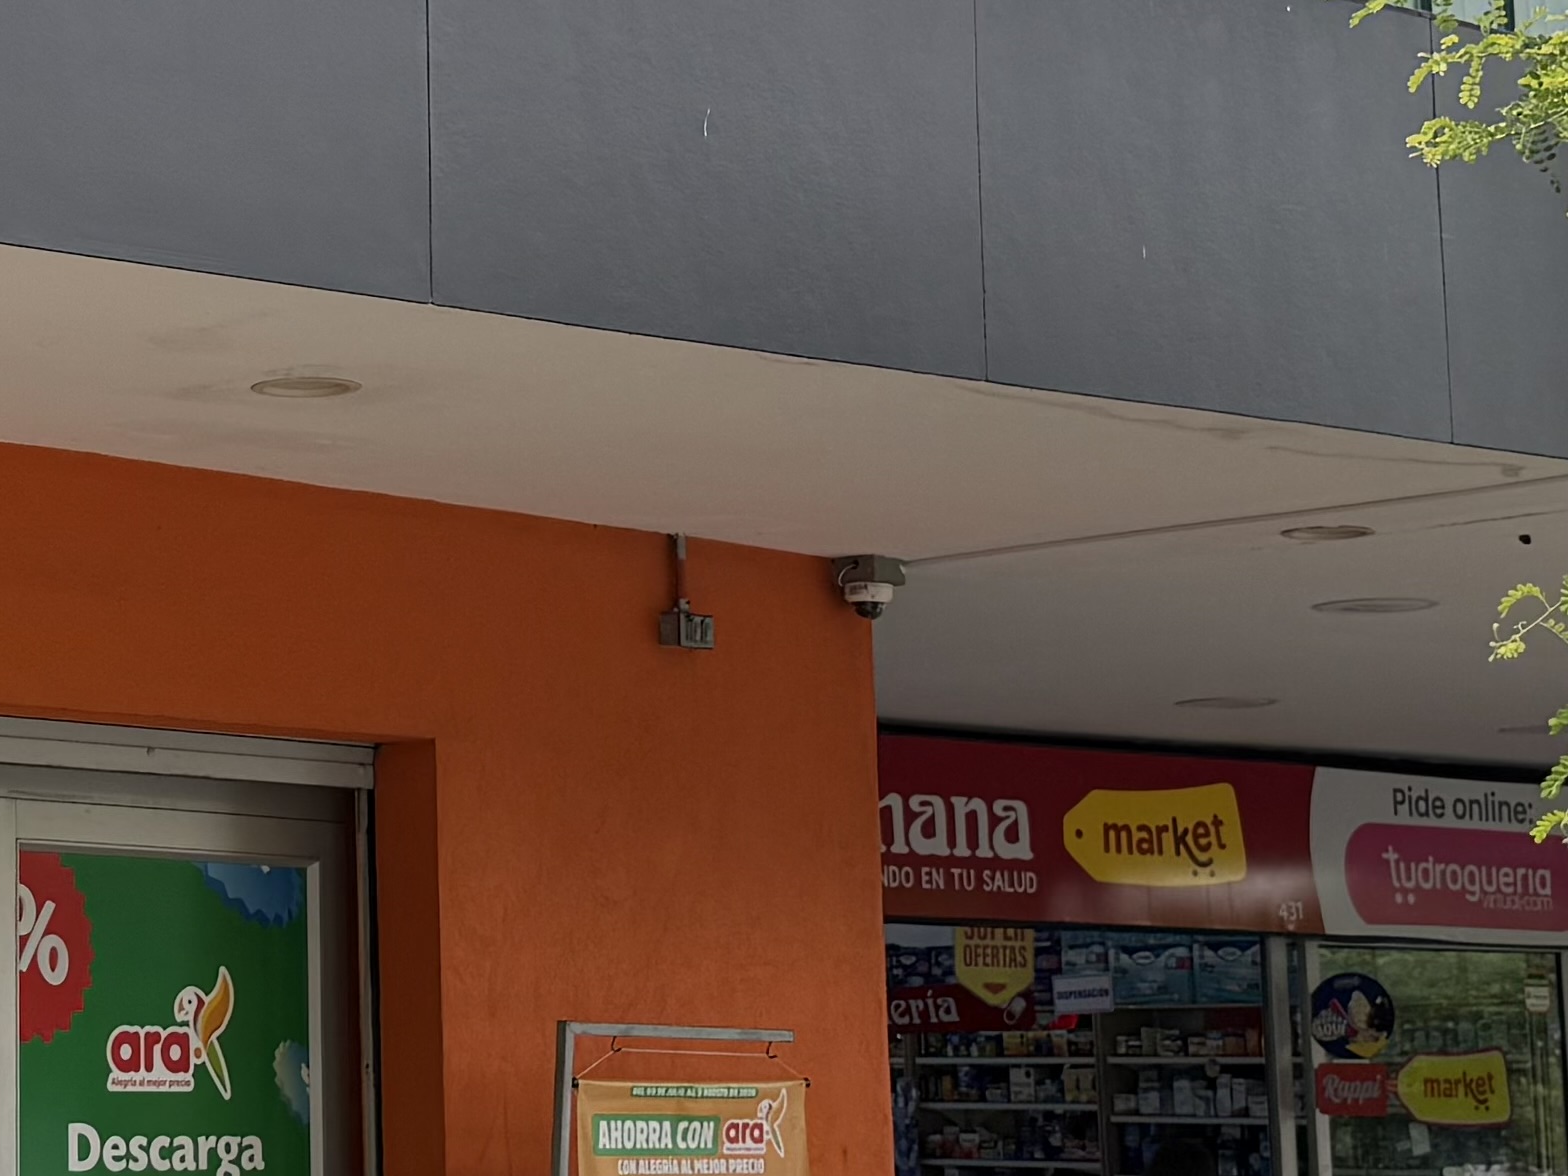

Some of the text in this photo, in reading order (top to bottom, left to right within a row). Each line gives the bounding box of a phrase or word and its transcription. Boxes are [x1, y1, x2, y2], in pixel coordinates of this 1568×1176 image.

[1393, 785, 1532, 825] Pide online:
[1102, 813, 1227, 867] market
[921, 867, 944, 890] EN
[950, 868, 975, 891] TU
[983, 869, 1037, 894] SALUD
[1279, 901, 1303, 920] 431
[963, 944, 1028, 968] OFERTAS
[111, 1031, 190, 1073] ara
[1322, 1074, 1381, 1105] Rappi
[1424, 1069, 1495, 1104] market
[598, 1120, 764, 1150] AHORRA CON ara
[618, 1159, 636, 1175] CON
[681, 1159, 694, 1174] AL
[694, 1159, 729, 1174] MEJOR
[729, 1158, 765, 1174] PRECIO
